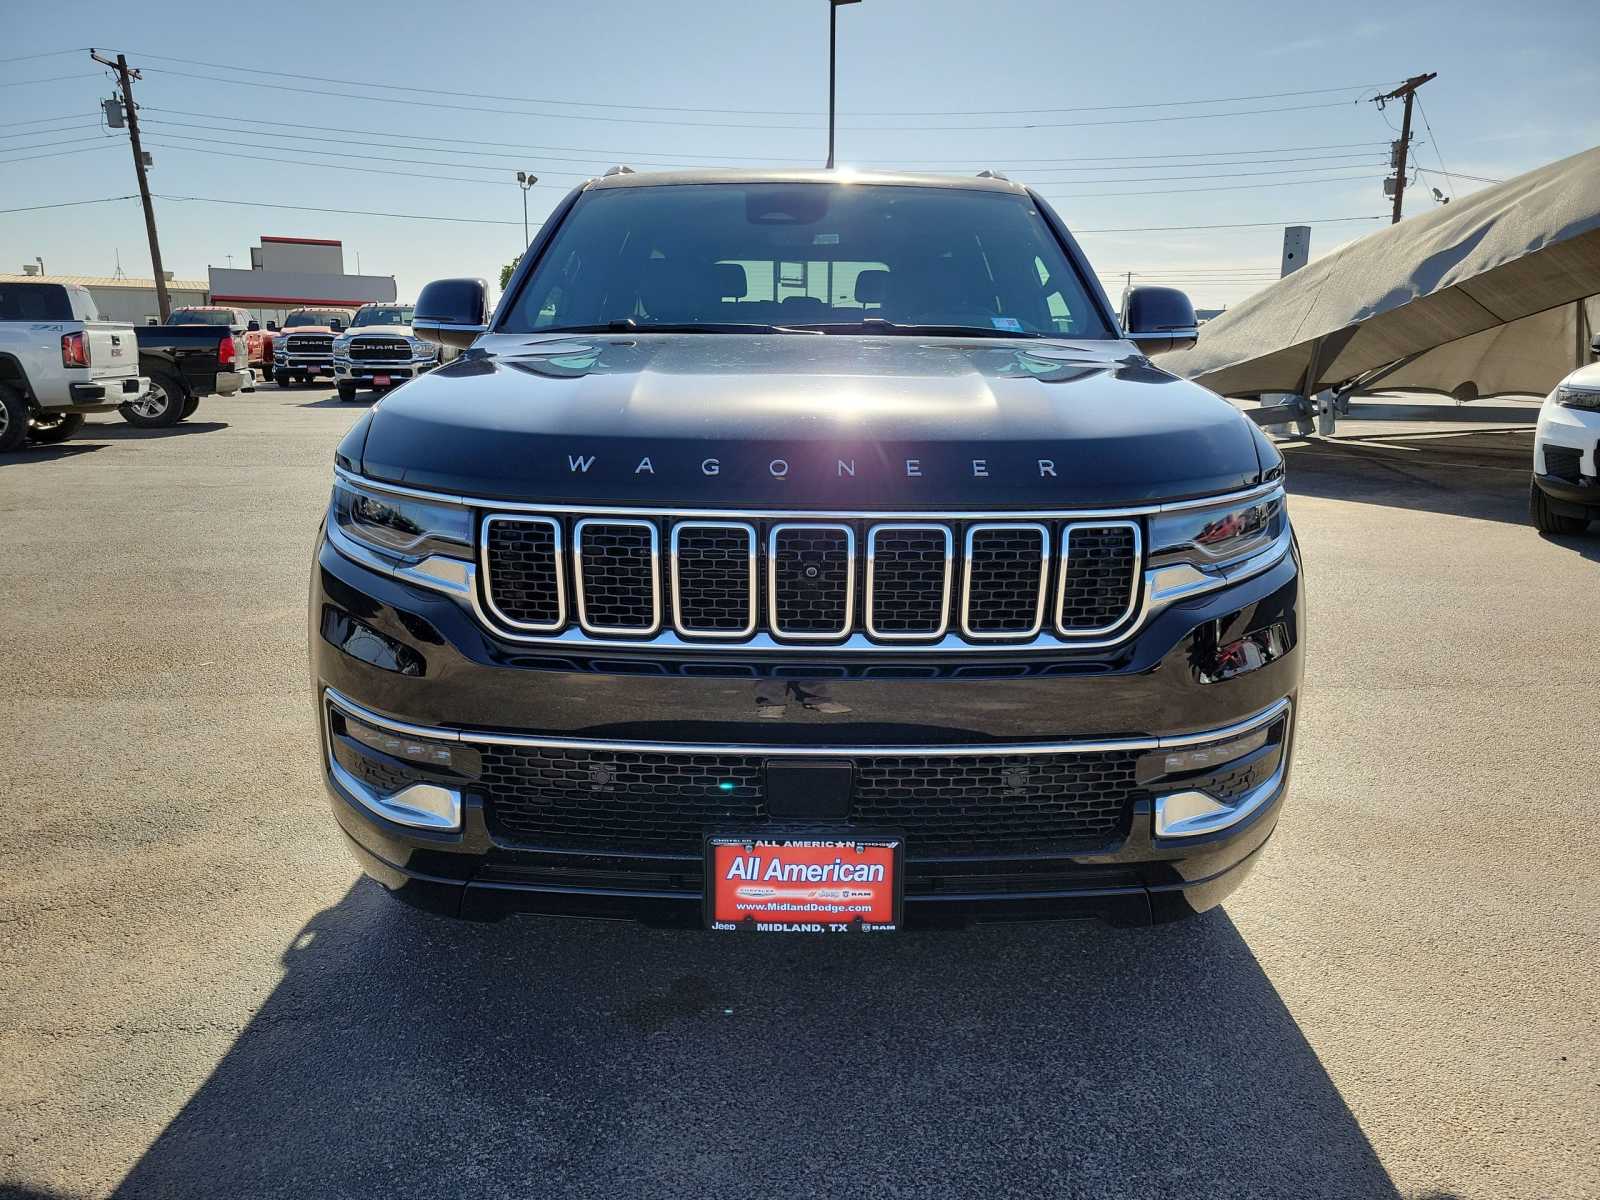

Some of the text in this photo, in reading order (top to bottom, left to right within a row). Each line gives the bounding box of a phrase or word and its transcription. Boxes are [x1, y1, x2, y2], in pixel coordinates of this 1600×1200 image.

[567, 454, 1058, 478] WAGONEER
[755, 840, 780, 848] ALL
[726, 856, 885, 883] All American
[736, 903, 872, 913] www.MidlandDodge.com
[711, 922, 736, 931] Jeep
[756, 923, 848, 932] MIDLAND, TX
